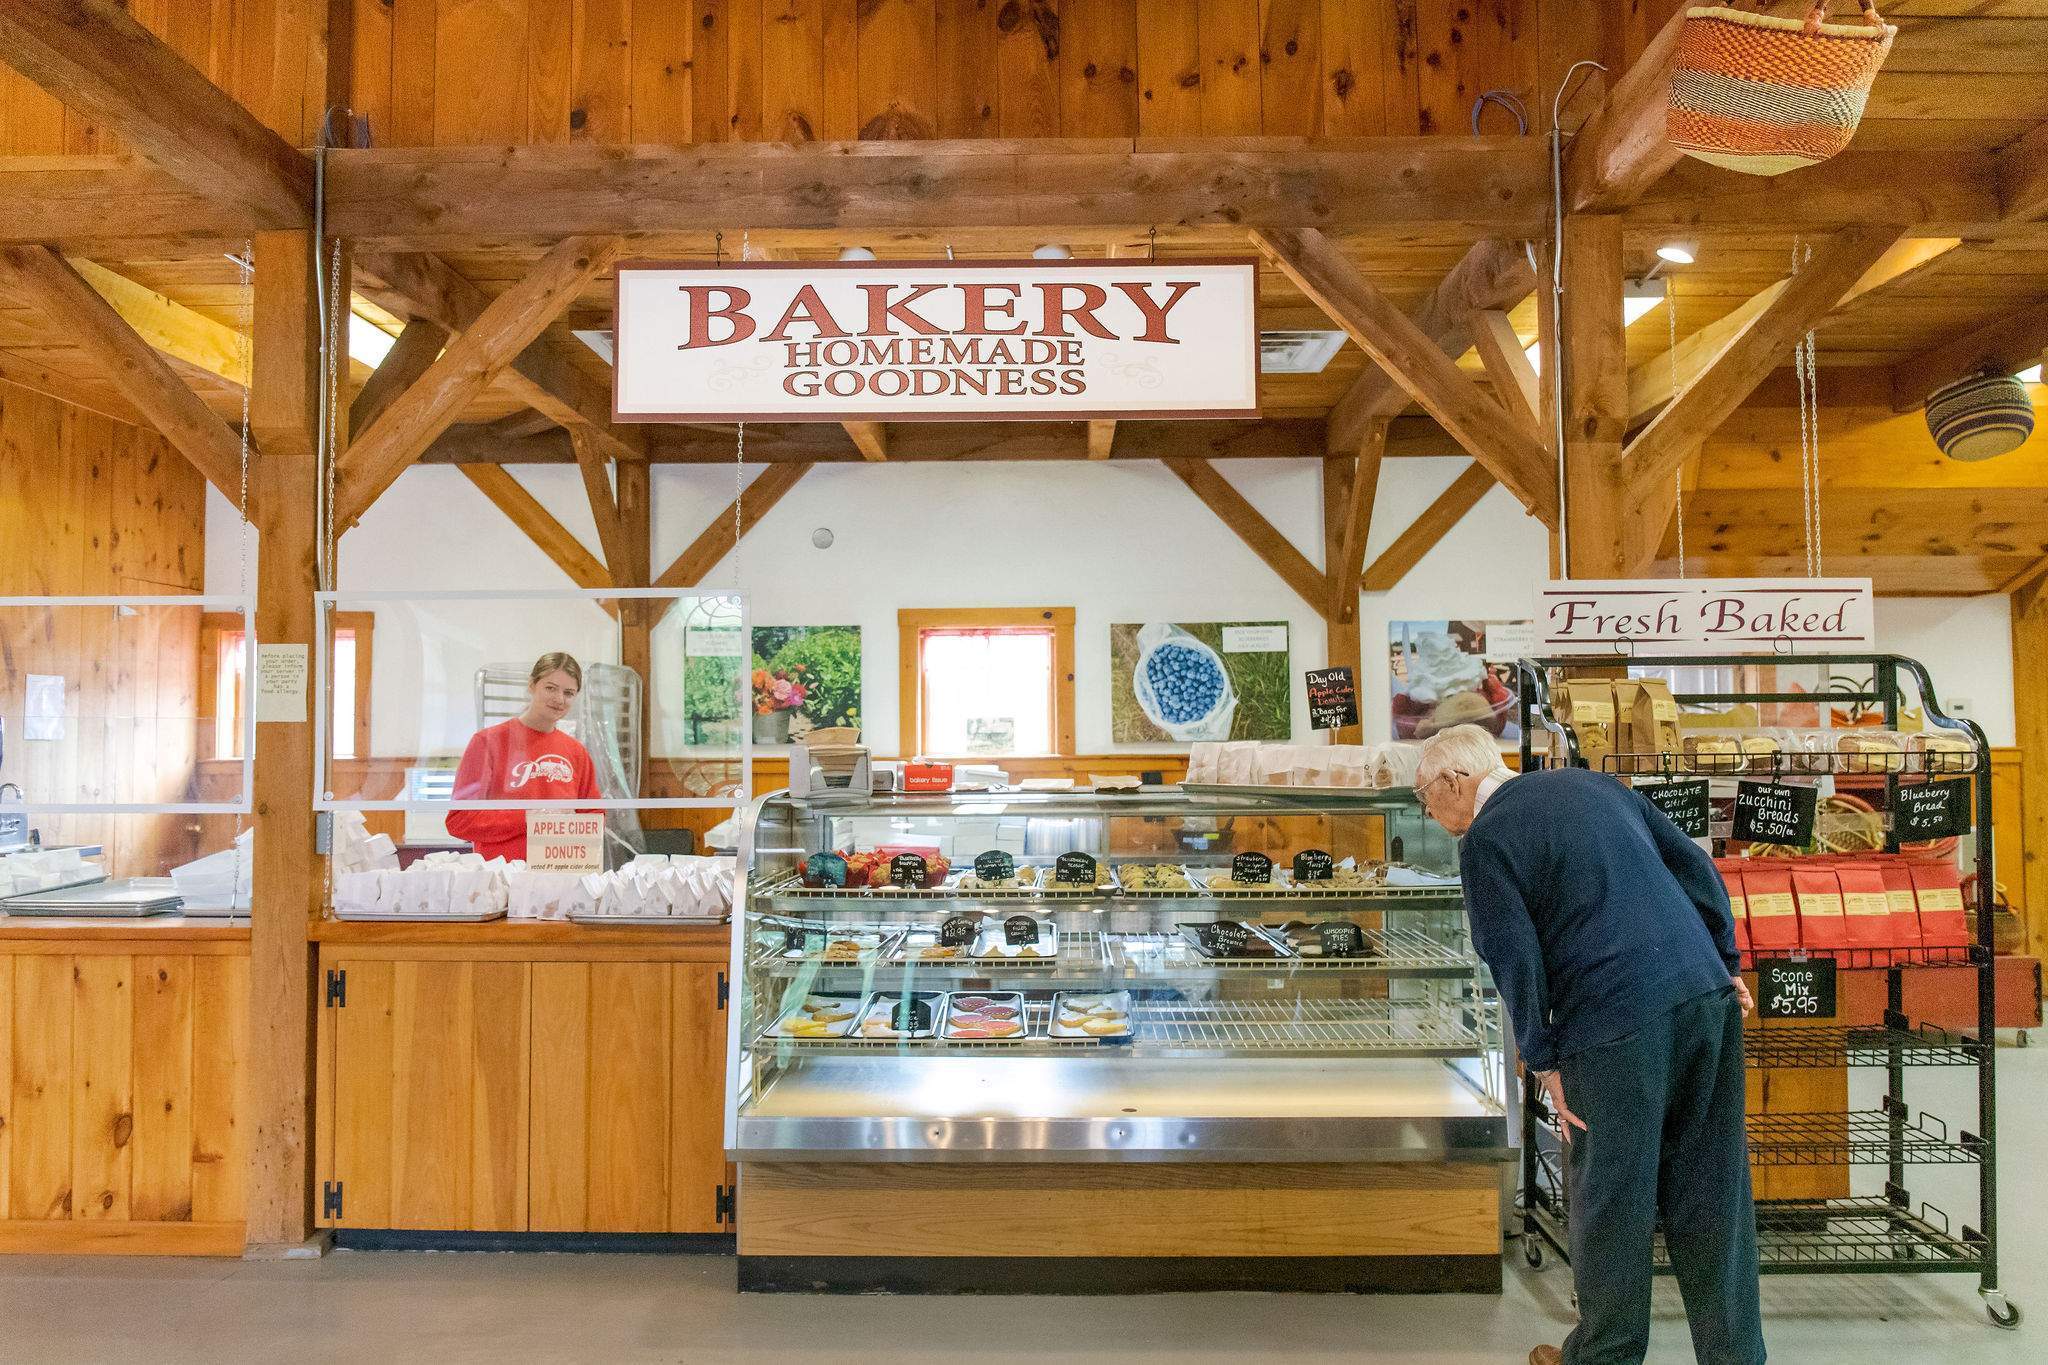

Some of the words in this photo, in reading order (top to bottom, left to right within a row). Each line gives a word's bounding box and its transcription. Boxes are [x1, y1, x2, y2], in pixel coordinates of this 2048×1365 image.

[678, 281, 1201, 350] BAKERY
[784, 338, 1086, 369] HOMEMADE
[782, 369, 1086, 397] GOODNESS
[1549, 599, 1682, 634] Fresh
[1700, 598, 1857, 633] Baked
[1307, 673, 1328, 687] Day
[1328, 671, 1346, 681] Old
[1309, 687, 1336, 698] Apple
[1336, 685, 1354, 694] Cider
[1317, 695, 1346, 705] Donuts
[909, 776, 931, 784] bakery
[1652, 786, 1702, 800] CHOCOLATE
[1758, 785, 1771, 794] our
[1774, 788, 1791, 797] own
[1900, 788, 1950, 802] Blueberry
[1664, 798, 1688, 808] CHIP
[1738, 793, 1792, 811] Zucchini
[1913, 801, 1946, 813] Bread
[1664, 807, 1699, 819] OKIES
[1758, 808, 1799, 824] Breads
[533, 821, 565, 835] APPLE
[568, 821, 598, 835] CIDER
[545, 845, 586, 859] DONUTS
[1300, 852, 1331, 865] Blueberry
[554, 863, 569, 872] apple
[1210, 924, 1247, 939] Chocolate
[1218, 935, 1245, 947] Brownie
[1771, 968, 1813, 983] Scone
[1785, 982, 1809, 996] Mix
[1770, 994, 1818, 1014] $5.95
